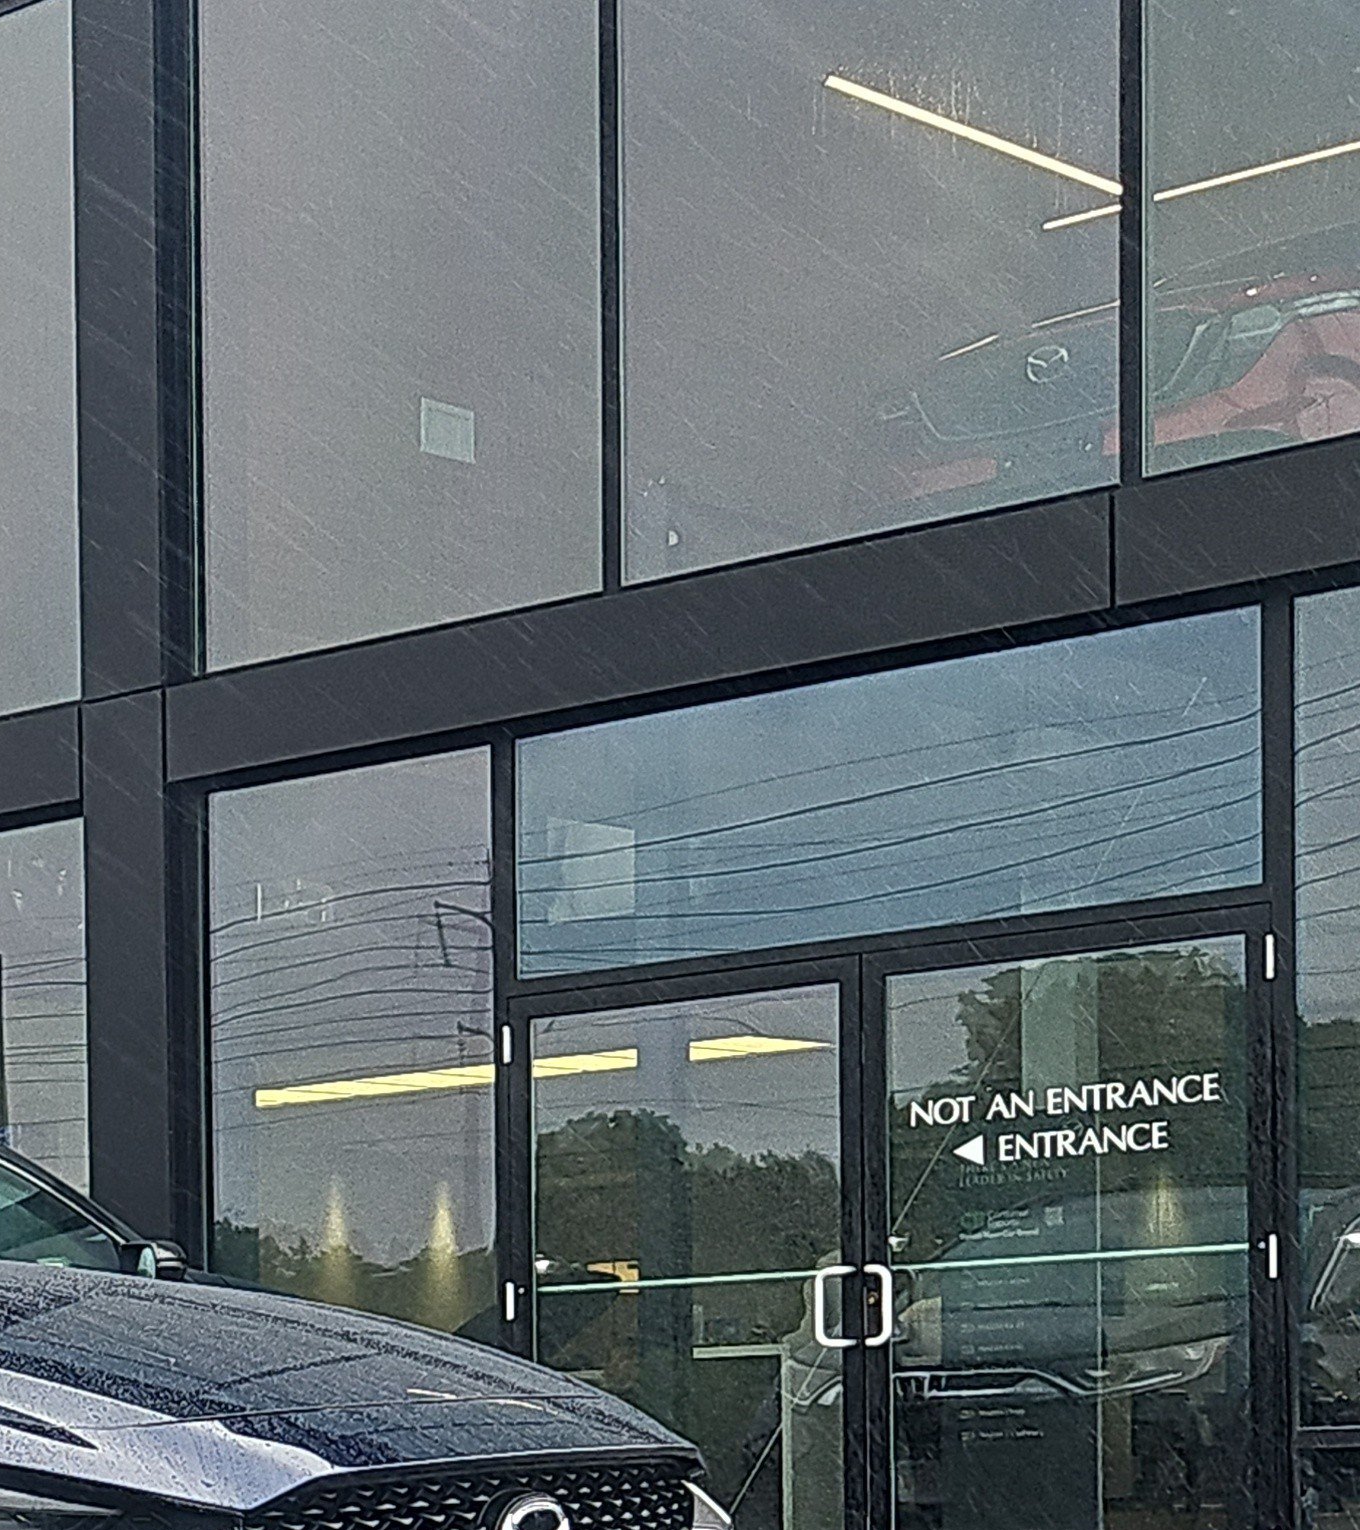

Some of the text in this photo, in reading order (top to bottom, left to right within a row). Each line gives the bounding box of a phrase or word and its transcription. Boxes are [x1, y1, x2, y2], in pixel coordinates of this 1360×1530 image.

[910, 1073, 1221, 1128] NOT AN ENTRANCE
[998, 1121, 1169, 1162] ENTRANCE
